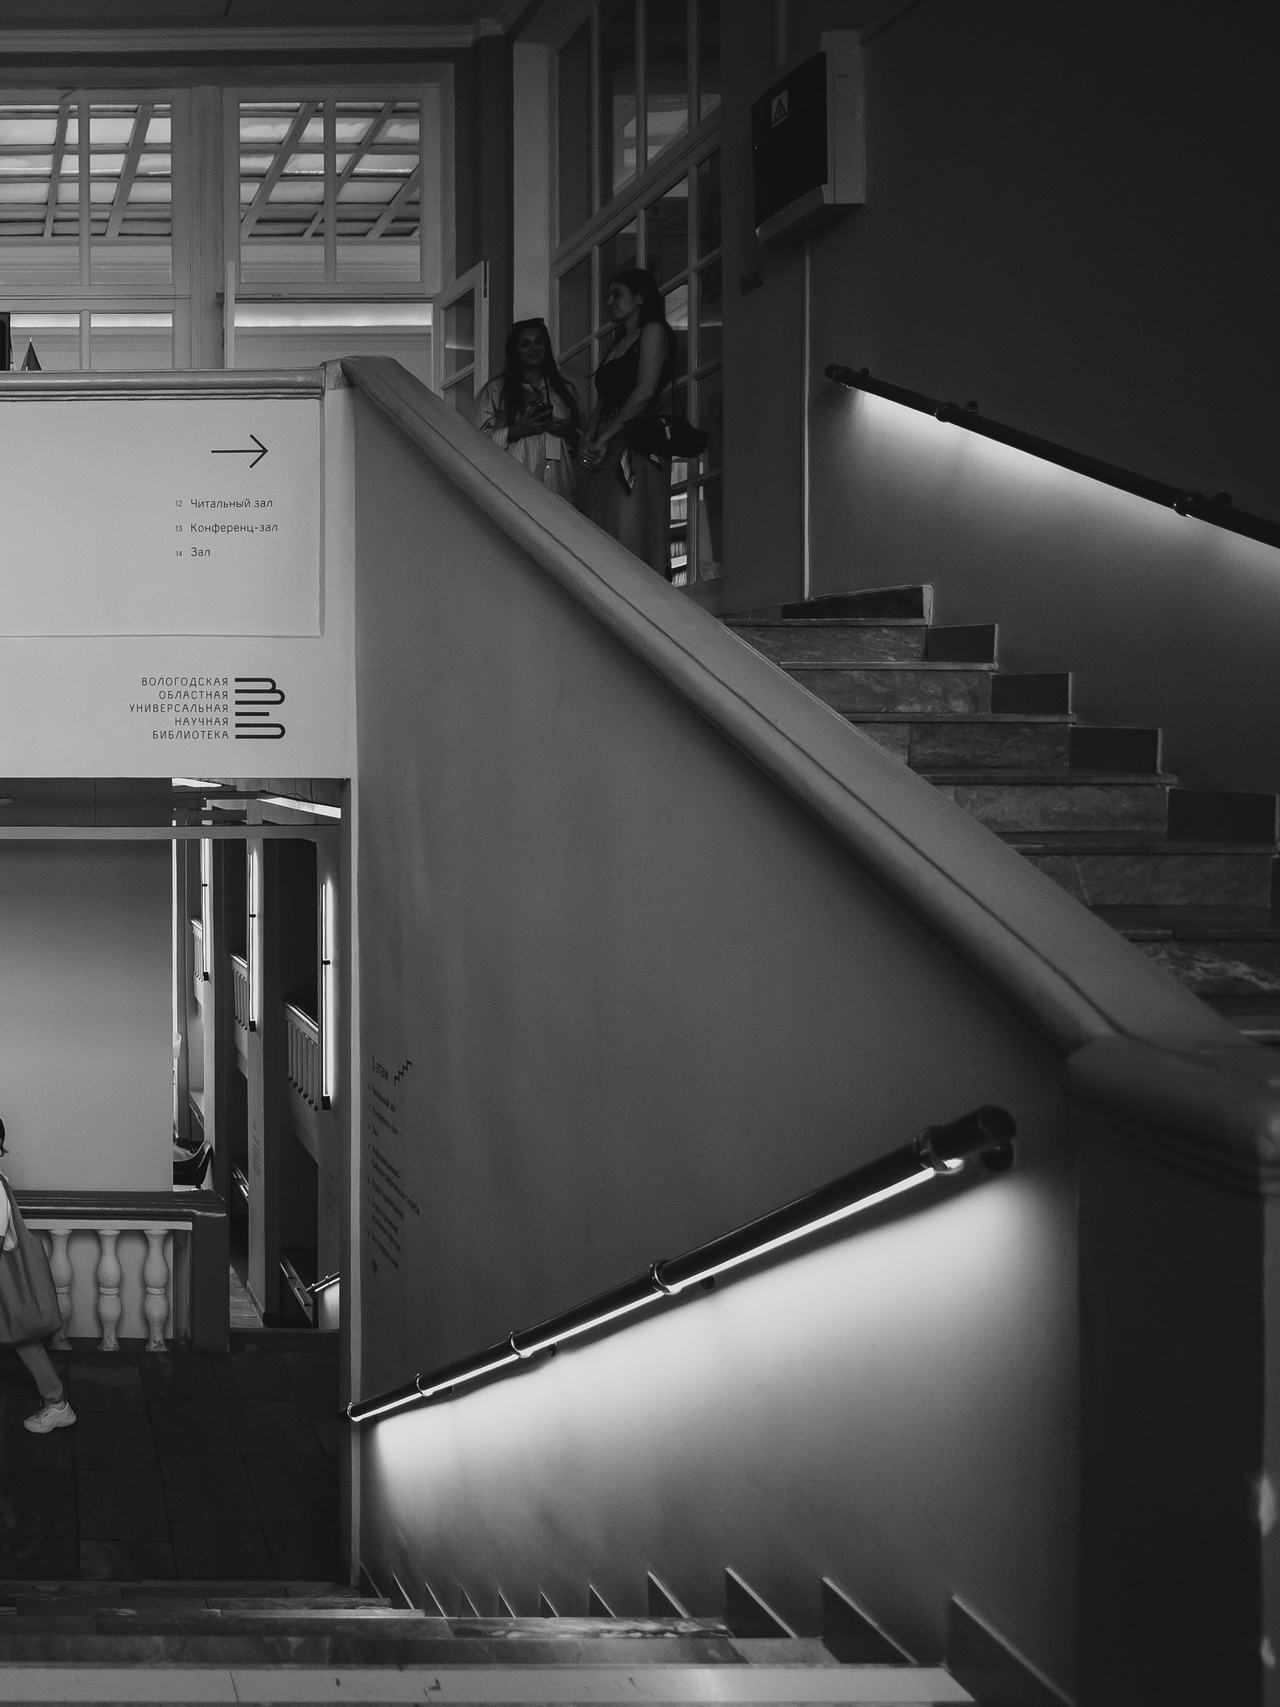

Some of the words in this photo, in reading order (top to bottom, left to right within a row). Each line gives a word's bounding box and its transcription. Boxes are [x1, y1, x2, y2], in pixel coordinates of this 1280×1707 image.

[175, 499, 183, 508] 12
[190, 498, 251, 509] Читальный
[253, 499, 273, 509] зал
[175, 524, 183, 532] 13
[190, 522, 278, 535] Конференц-зал
[175, 550, 183, 558] 14
[190, 546, 211, 557] Зал
[141, 676, 229, 688] ВОЛОГОДСКАЯ
[158, 690, 229, 700] ОБЛАСТНАЯ
[128, 703, 229, 713] УНИВЕРСАЛЬНАЯ
[174, 717, 229, 726] НАУЧНАЯ
[152, 730, 230, 740] БИБЛИОТЕКА
